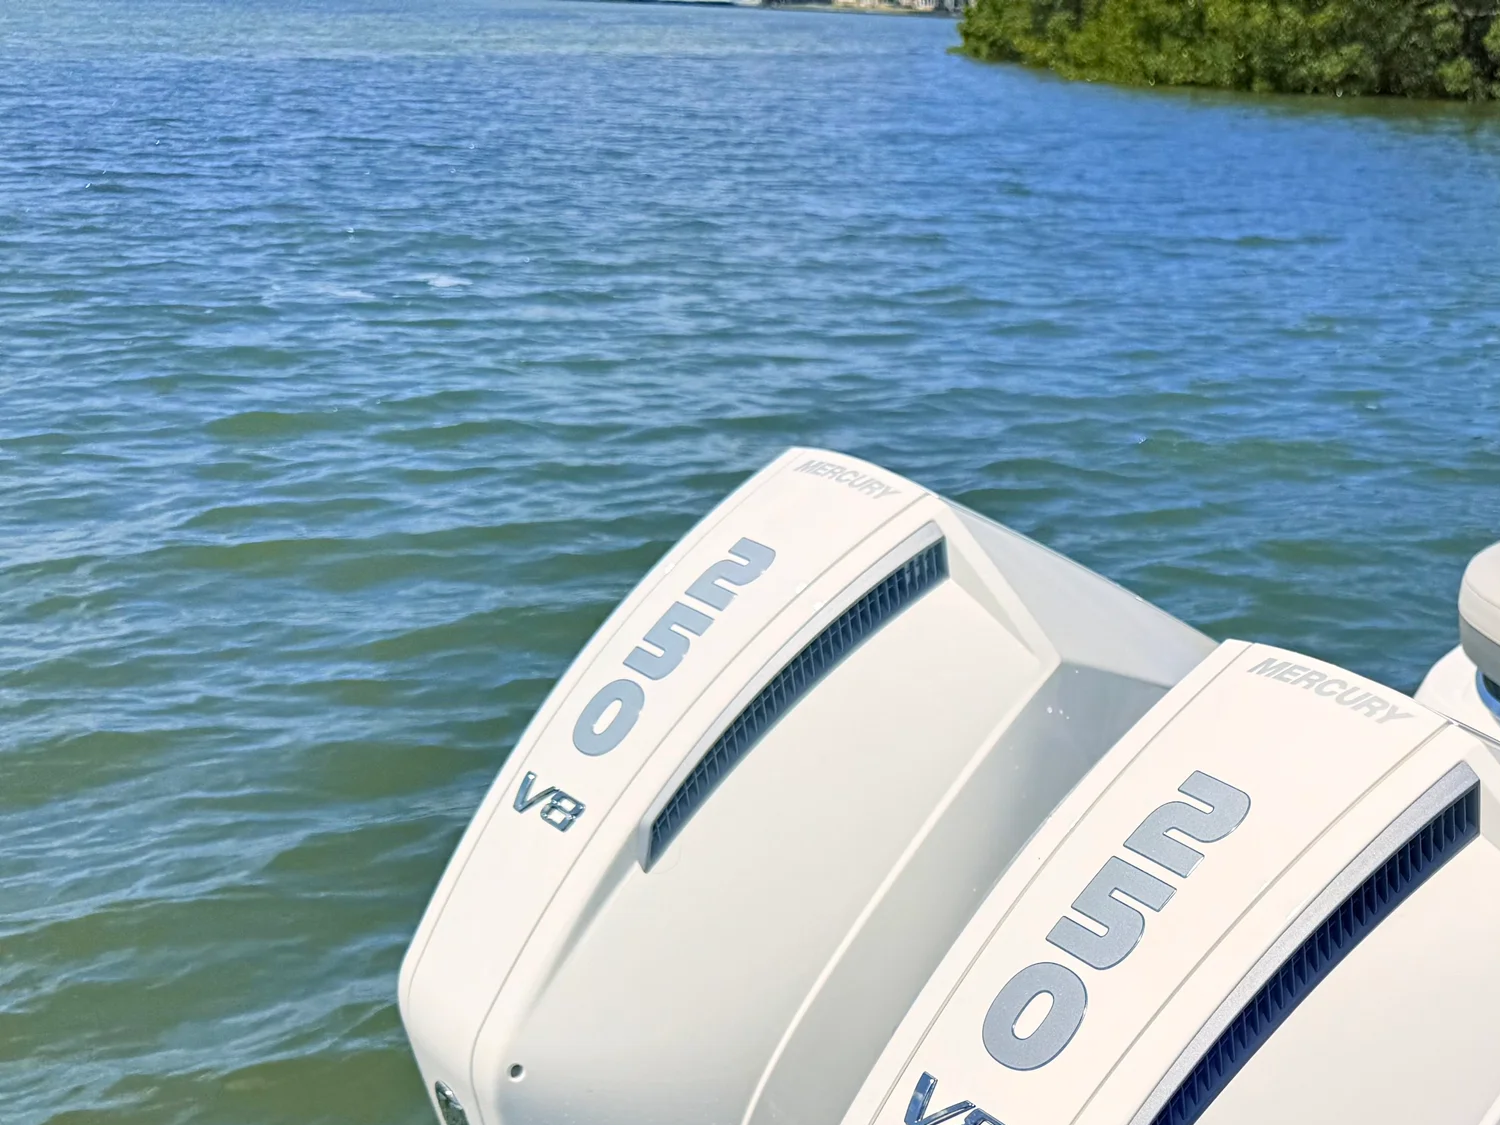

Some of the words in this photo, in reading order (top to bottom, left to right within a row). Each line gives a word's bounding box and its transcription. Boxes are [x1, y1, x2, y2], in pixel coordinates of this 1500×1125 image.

[793, 460, 902, 499] MERCURY
[572, 537, 776, 757] 250
[1247, 657, 1415, 724] MERCURY
[512, 771, 586, 832] V8
[982, 769, 1251, 1071] 250
